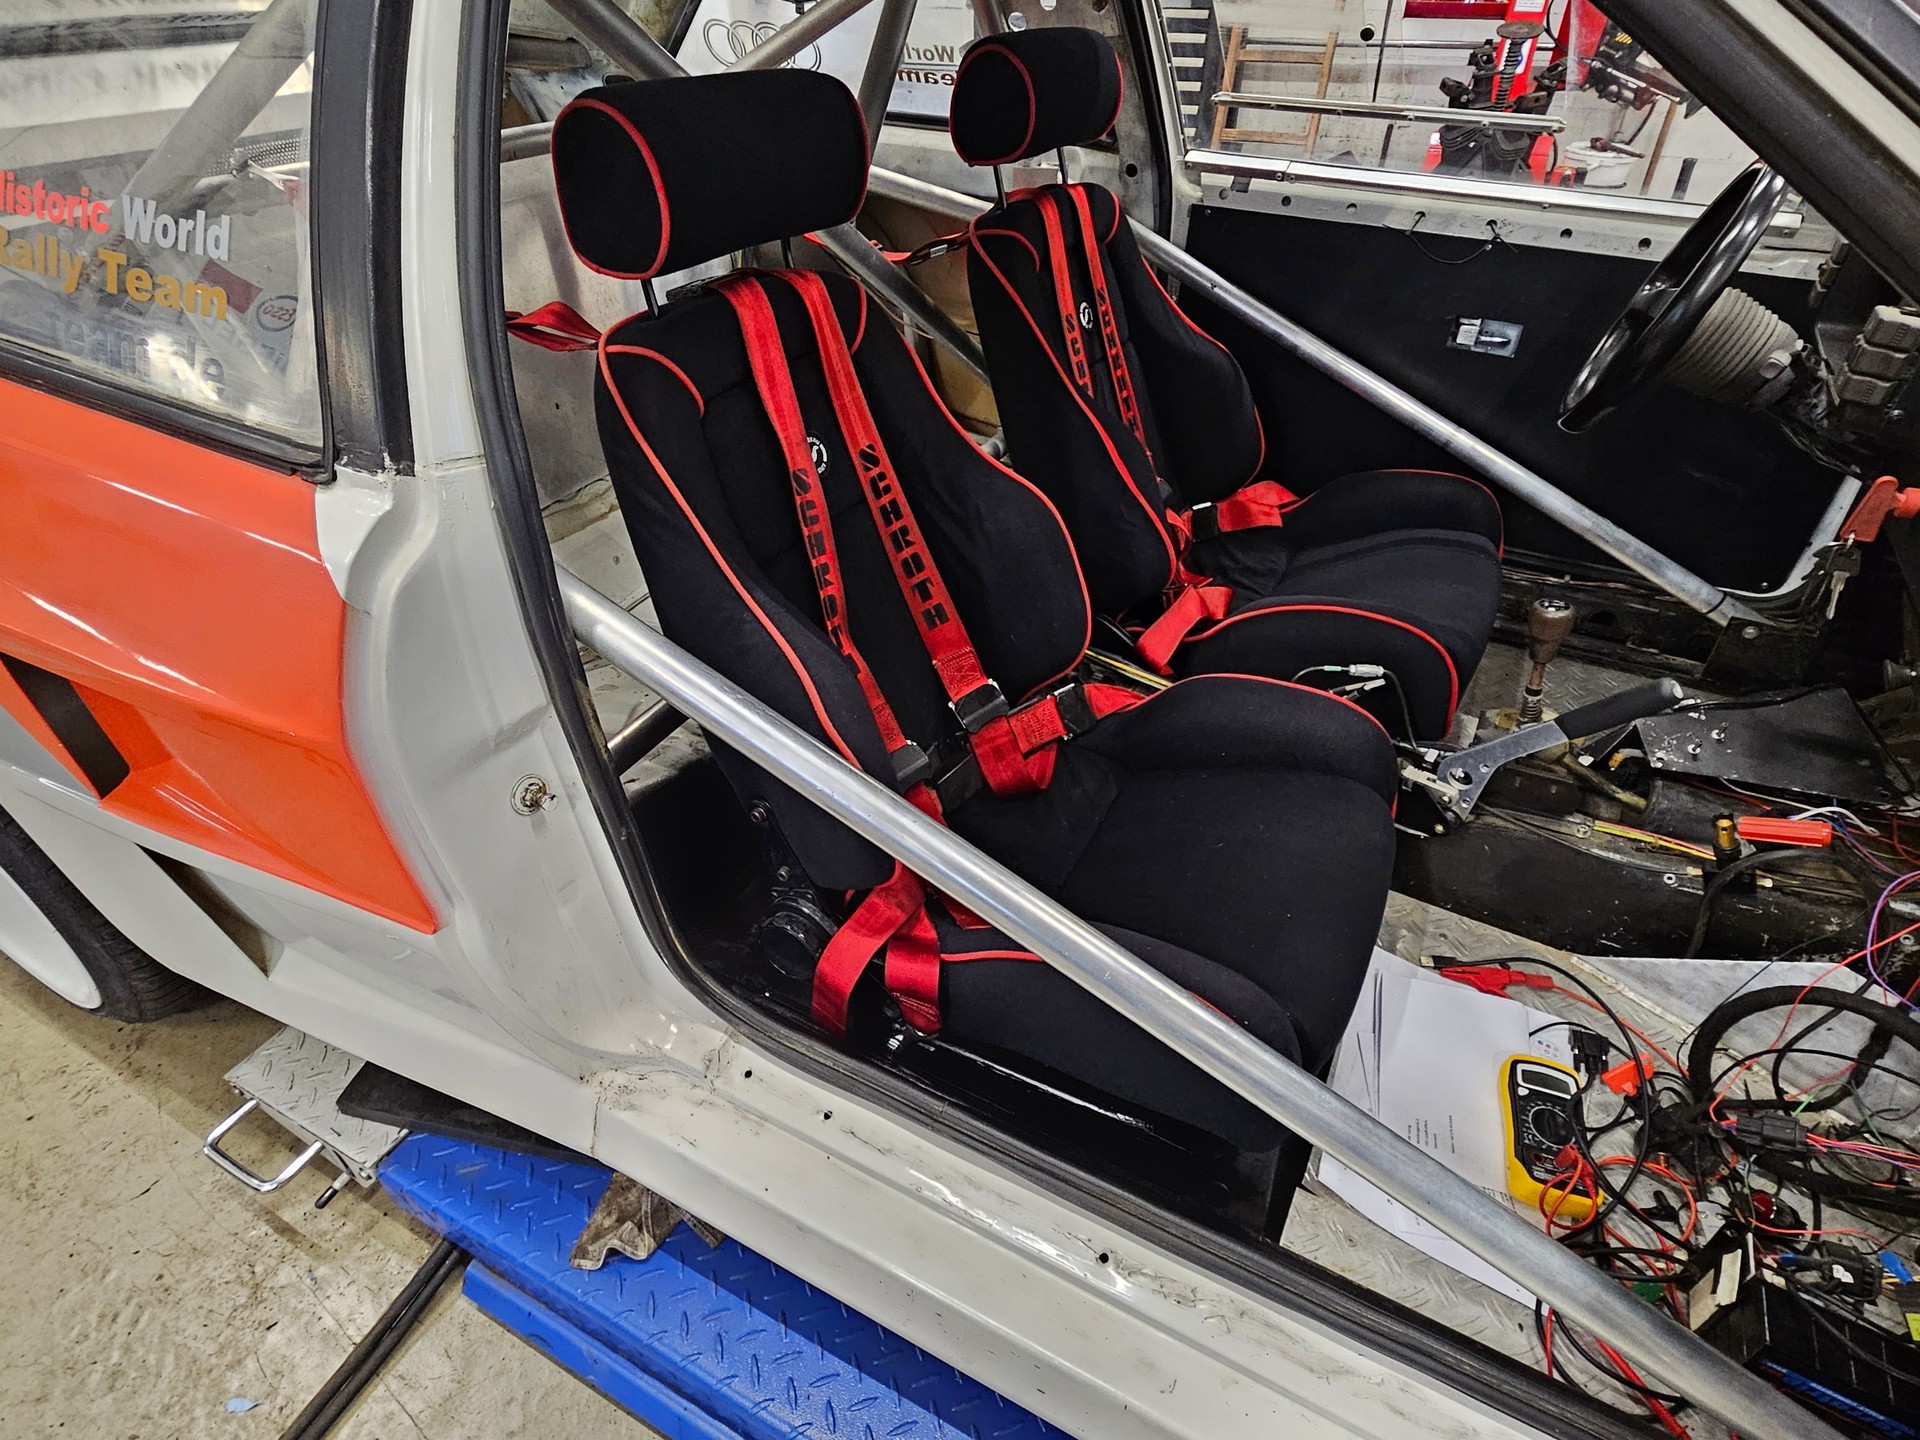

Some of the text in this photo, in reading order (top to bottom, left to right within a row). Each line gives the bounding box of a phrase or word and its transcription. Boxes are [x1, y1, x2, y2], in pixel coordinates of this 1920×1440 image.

[122, 194, 231, 262] World
[97, 247, 229, 321] Team
[857, 442, 950, 632] SCHROTH
